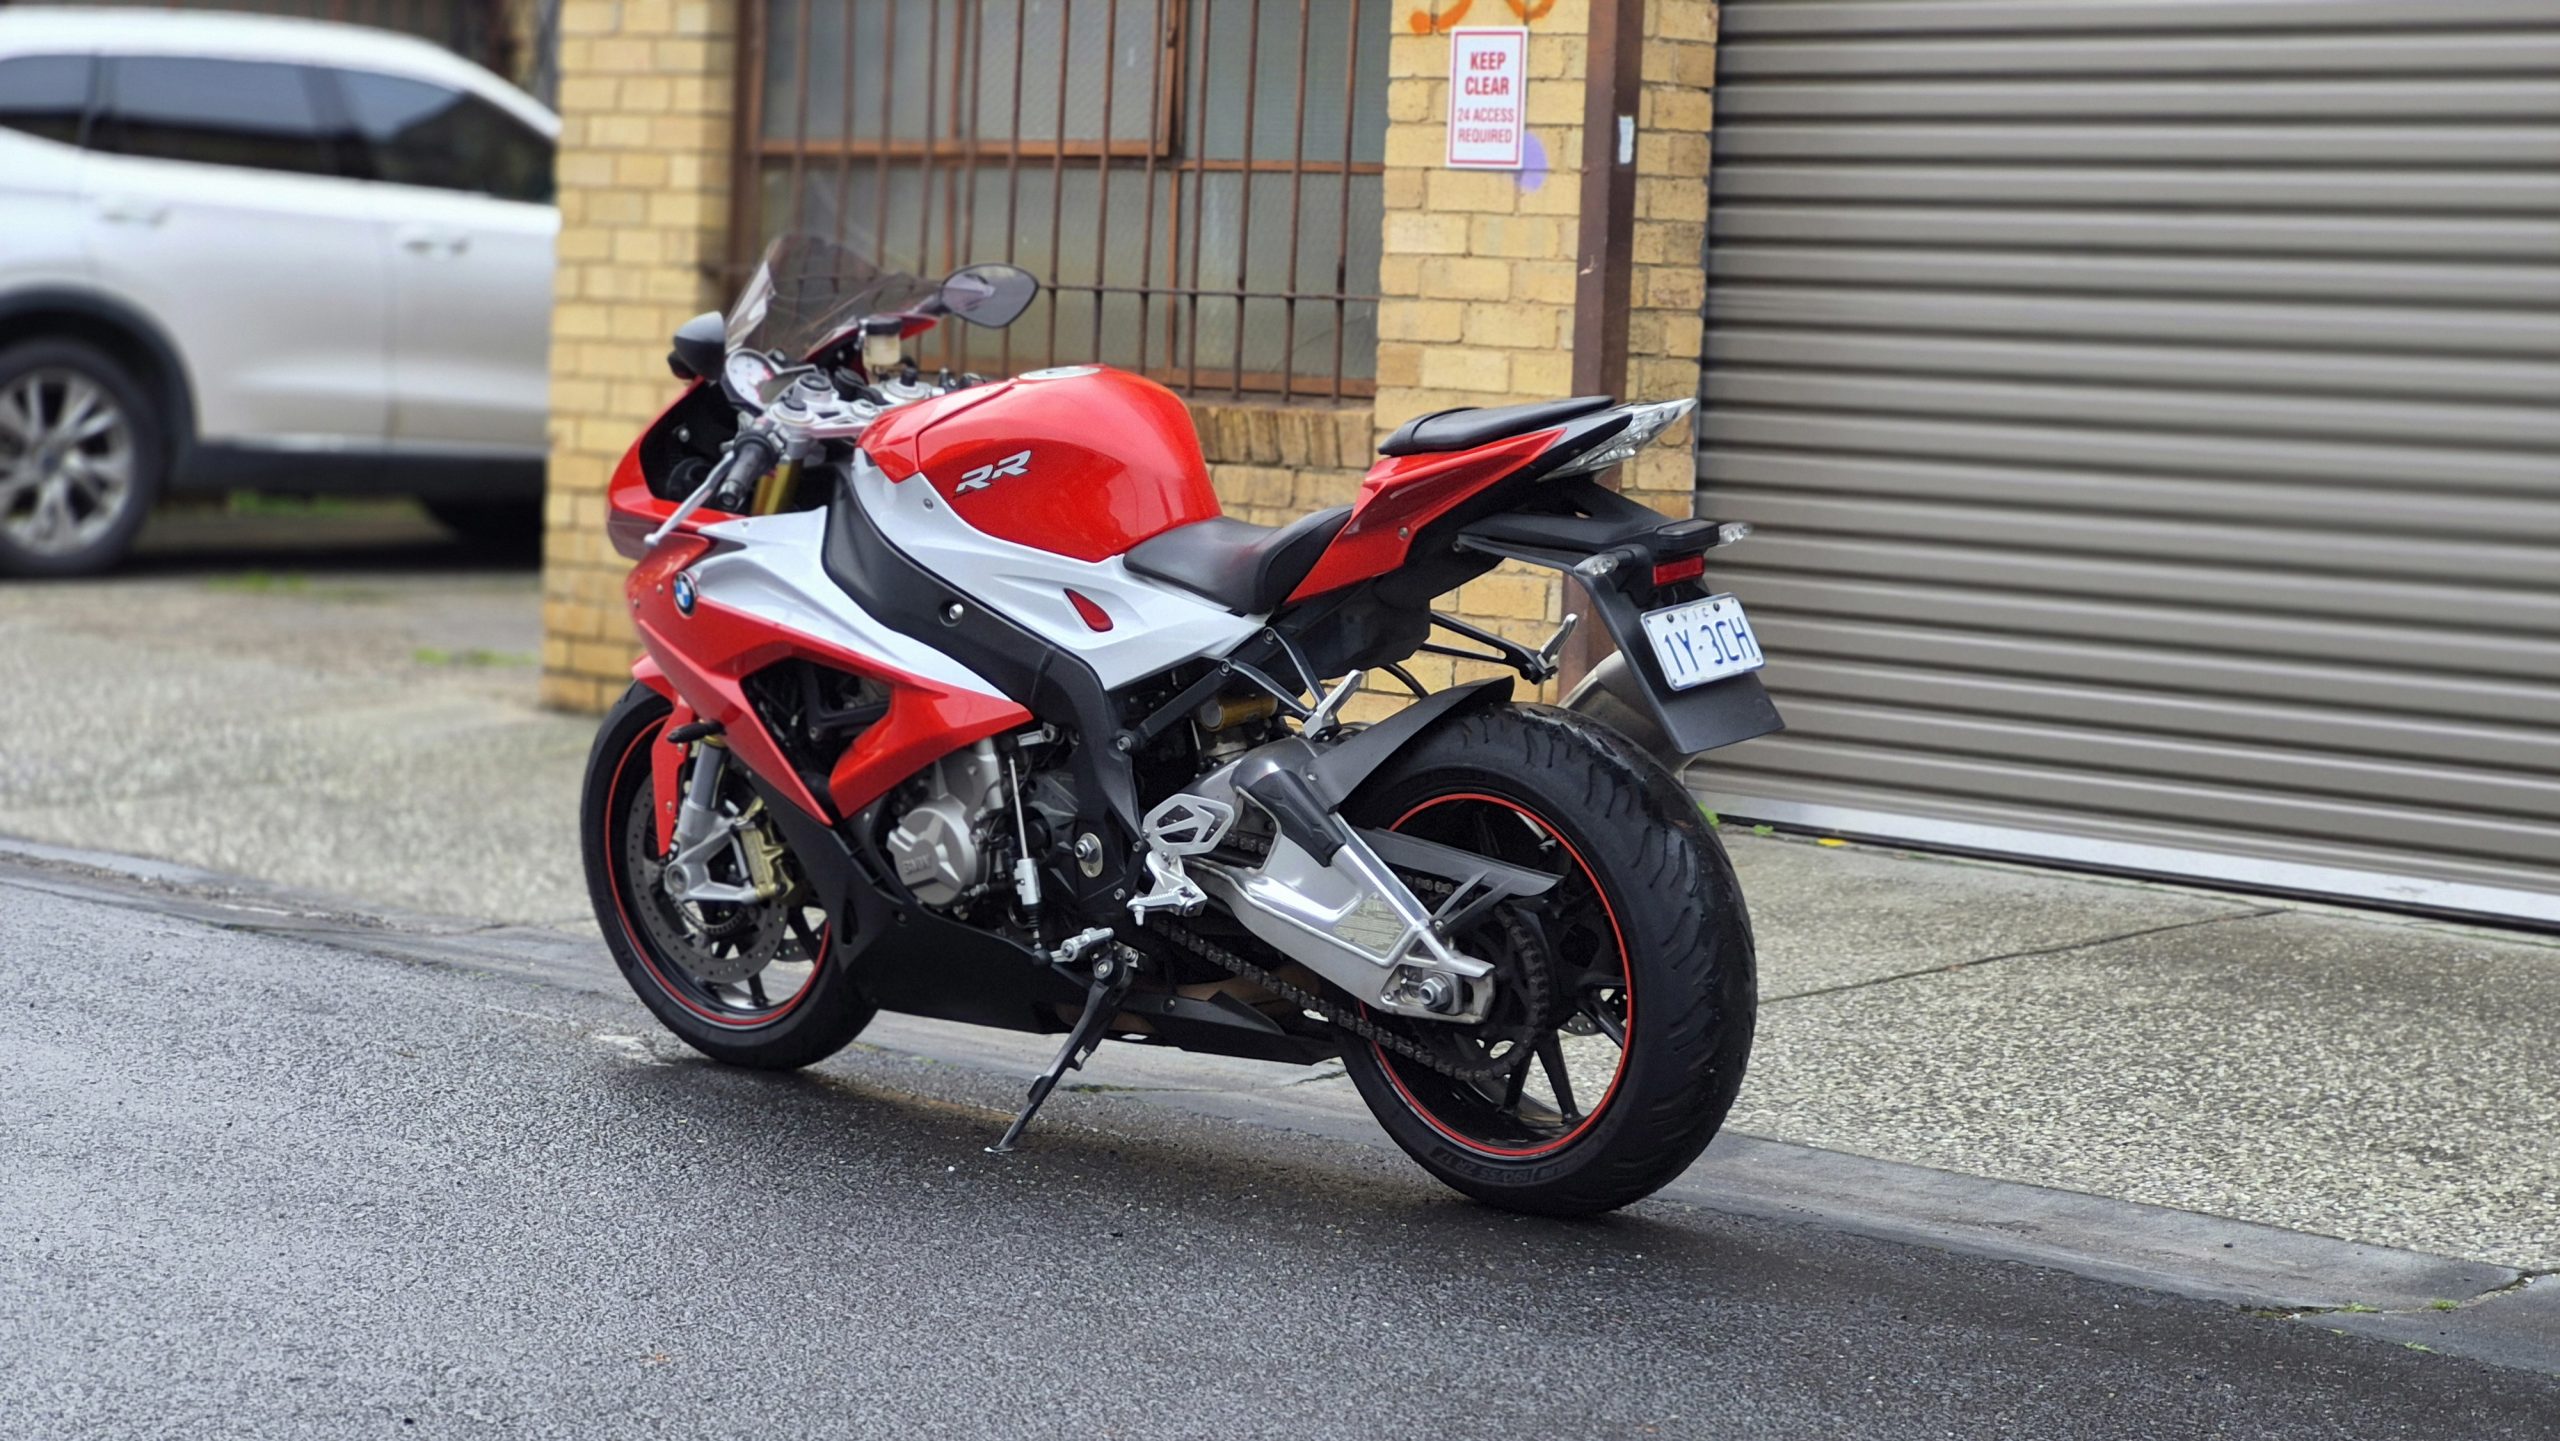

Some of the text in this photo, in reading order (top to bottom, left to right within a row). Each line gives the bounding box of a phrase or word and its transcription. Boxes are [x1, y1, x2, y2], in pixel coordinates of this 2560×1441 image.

[1470, 52, 1506, 70] KEEP
[1465, 76, 1509, 95] CLEAR
[1457, 107, 1515, 122] 24 ACCESS
[1457, 128, 1513, 143] REQUIRED
[956, 450, 1031, 492] RR
